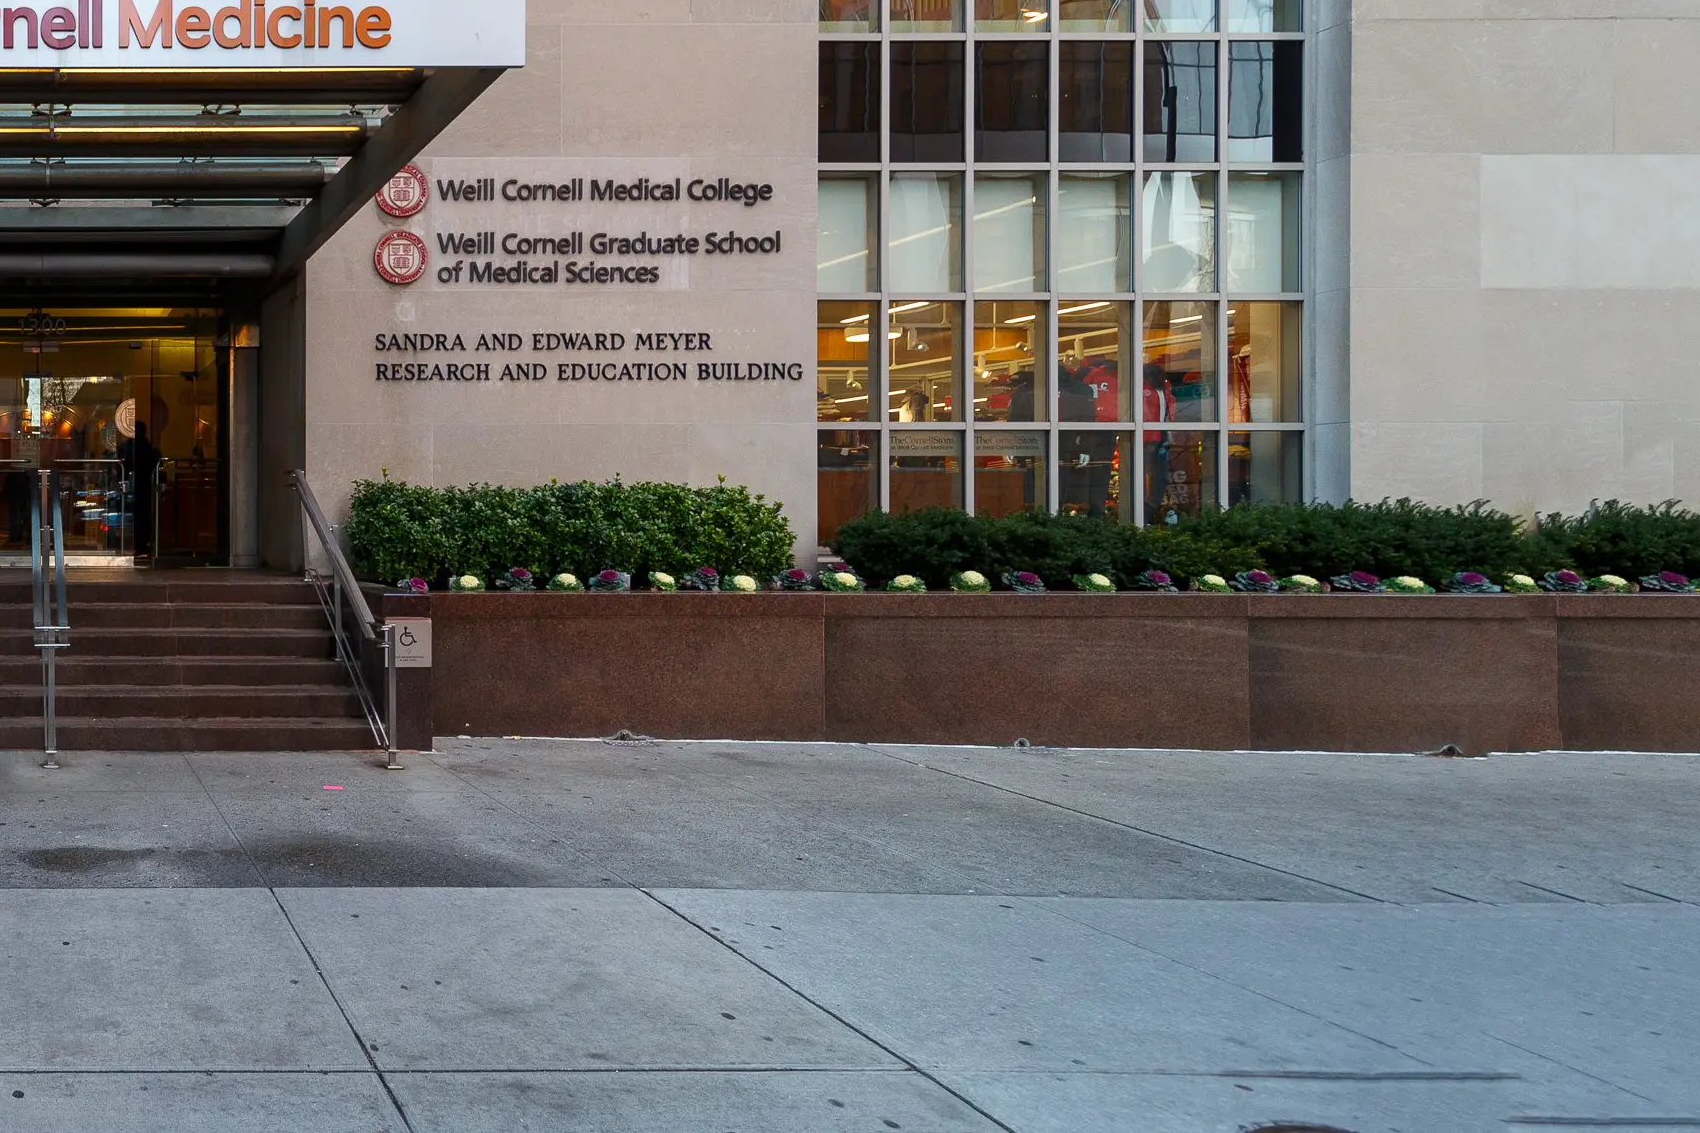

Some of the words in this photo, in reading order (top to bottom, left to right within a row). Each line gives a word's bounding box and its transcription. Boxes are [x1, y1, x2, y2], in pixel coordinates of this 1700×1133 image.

[436, 178, 495, 201] Weill
[501, 178, 583, 202] Cornell
[590, 178, 680, 202] Medical
[687, 177, 773, 206] College
[436, 232, 495, 254] Weill
[501, 232, 583, 254] Cornell
[589, 231, 699, 254] Graduate
[705, 230, 781, 254] School
[437, 260, 463, 283] of
[469, 260, 558, 283] Medical
[565, 260, 659, 284] Sciences
[18, 318, 66, 335] 1300
[375, 333, 466, 351] SANDRA
[475, 333, 523, 351] AND
[532, 333, 625, 351] EDWARD
[635, 333, 712, 351] MEYER
[375, 364, 490, 381] RESEARCH
[499, 364, 547, 381] AND
[557, 364, 687, 381] EDUCATION
[697, 363, 804, 381] BUILDING
